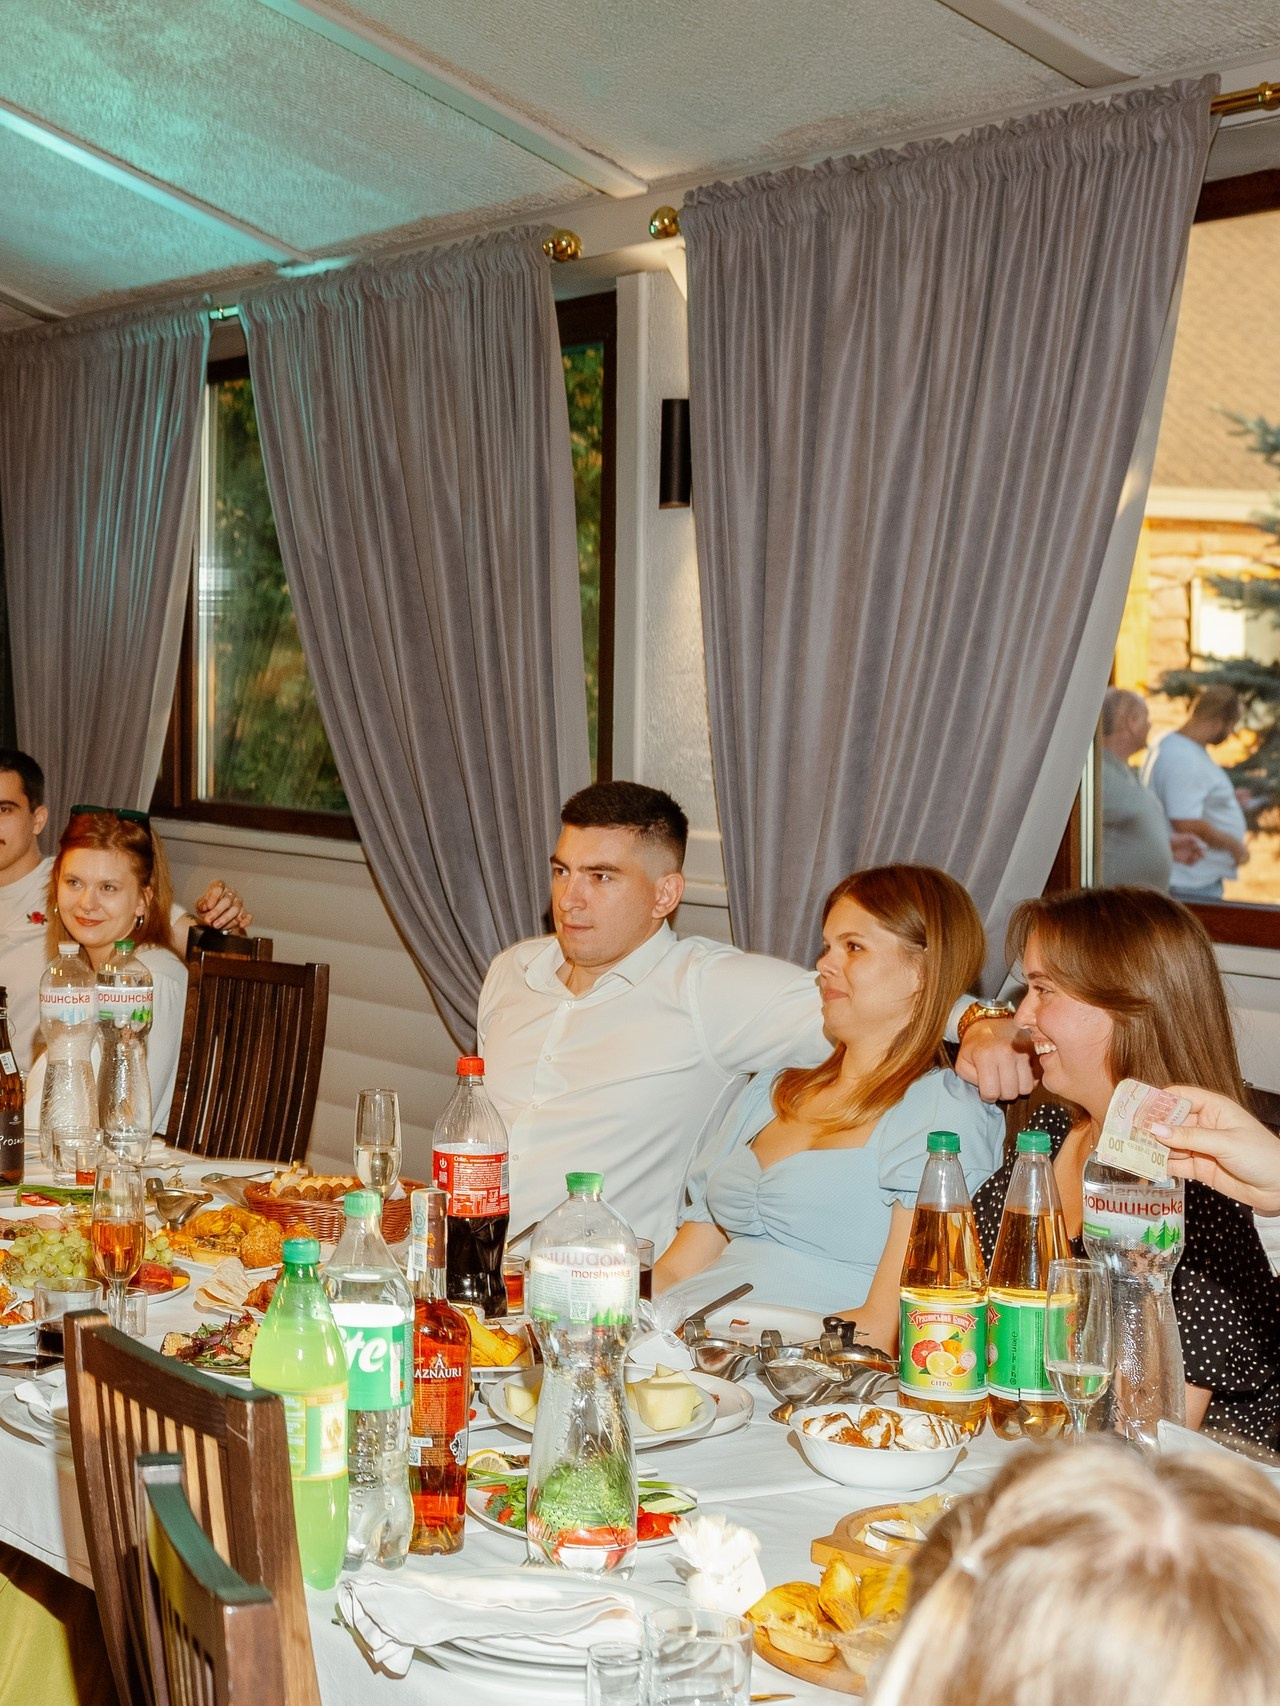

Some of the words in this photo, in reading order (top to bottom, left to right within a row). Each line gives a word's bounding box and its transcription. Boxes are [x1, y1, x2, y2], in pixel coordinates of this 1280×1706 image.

[39, 993, 91, 1004] ршинська
[98, 991, 153, 1004] оршинська
[1108, 1136, 1125, 1153] 100
[1151, 1151, 1166, 1168] 100
[414, 1367, 462, 1379] AZNAURI
